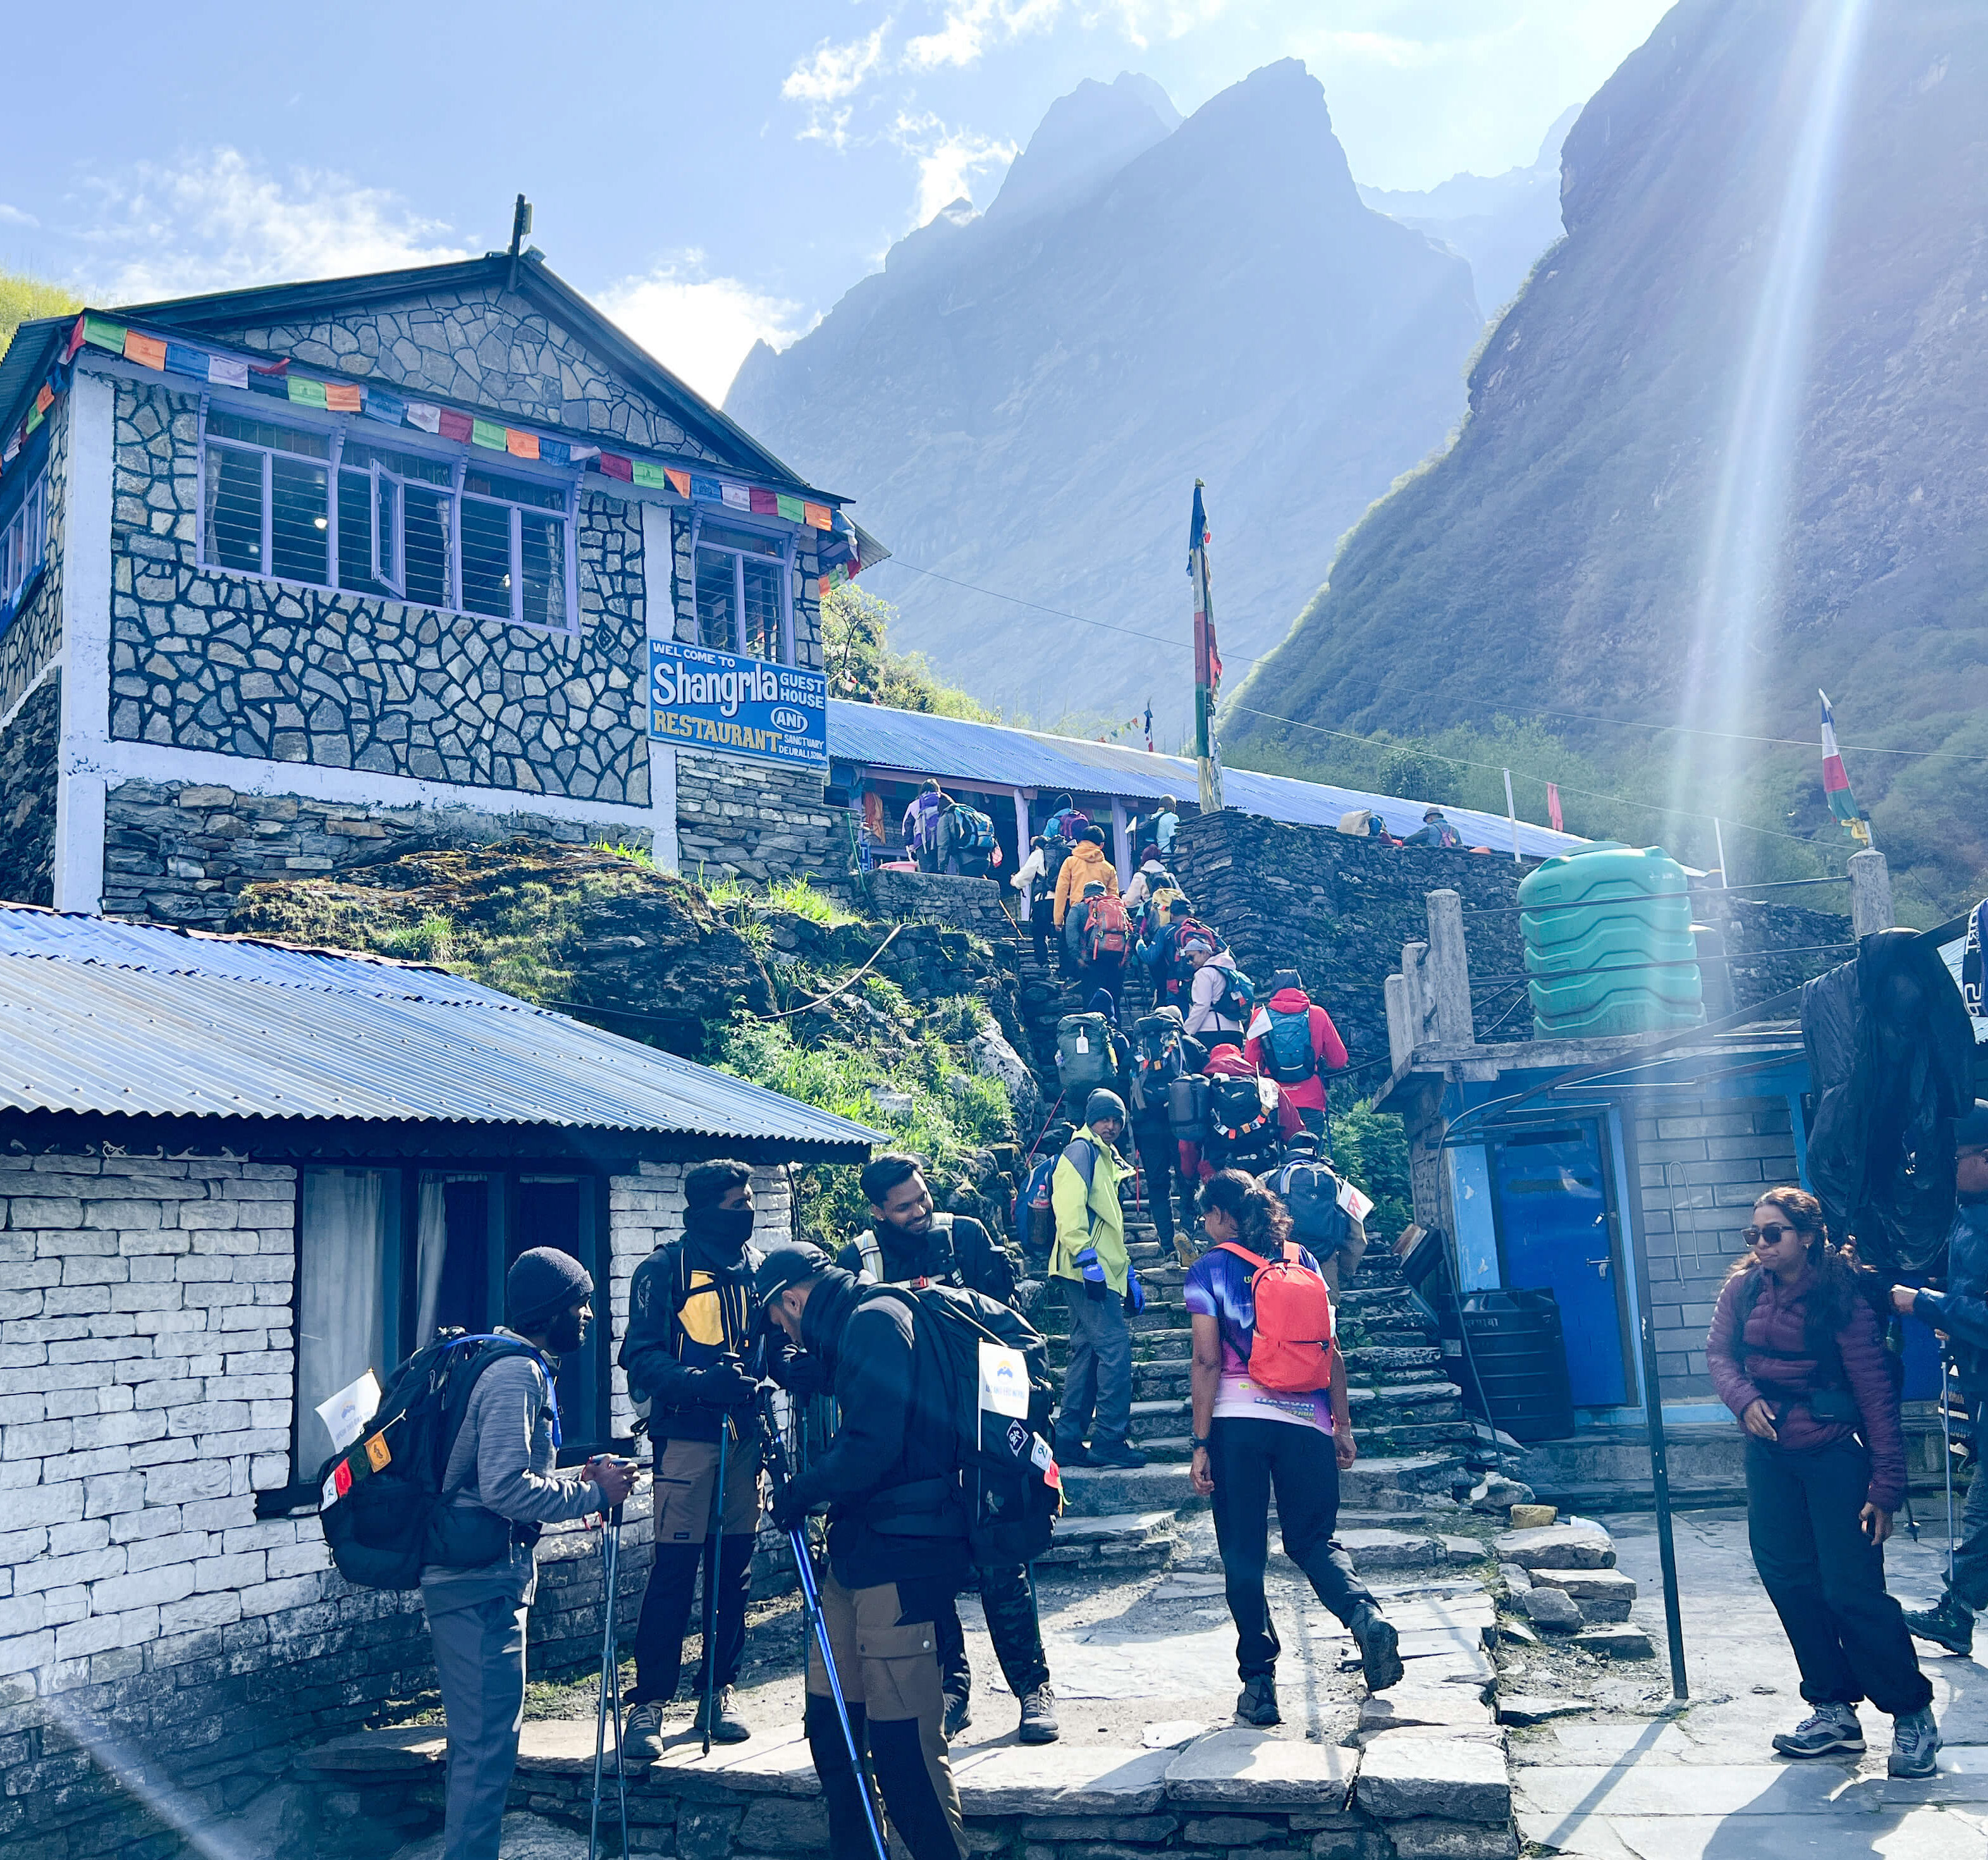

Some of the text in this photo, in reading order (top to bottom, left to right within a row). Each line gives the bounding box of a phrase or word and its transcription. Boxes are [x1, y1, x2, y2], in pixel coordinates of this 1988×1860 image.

[718, 656, 735, 668] TO
[652, 662, 778, 717] Shangrila
[780, 672, 825, 694] GUEST
[780, 687, 825, 710] HOUSE
[653, 709, 783, 753] RESTAURANT
[776, 711, 806, 729] AND
[784, 734, 825, 750] SANCTUARY
